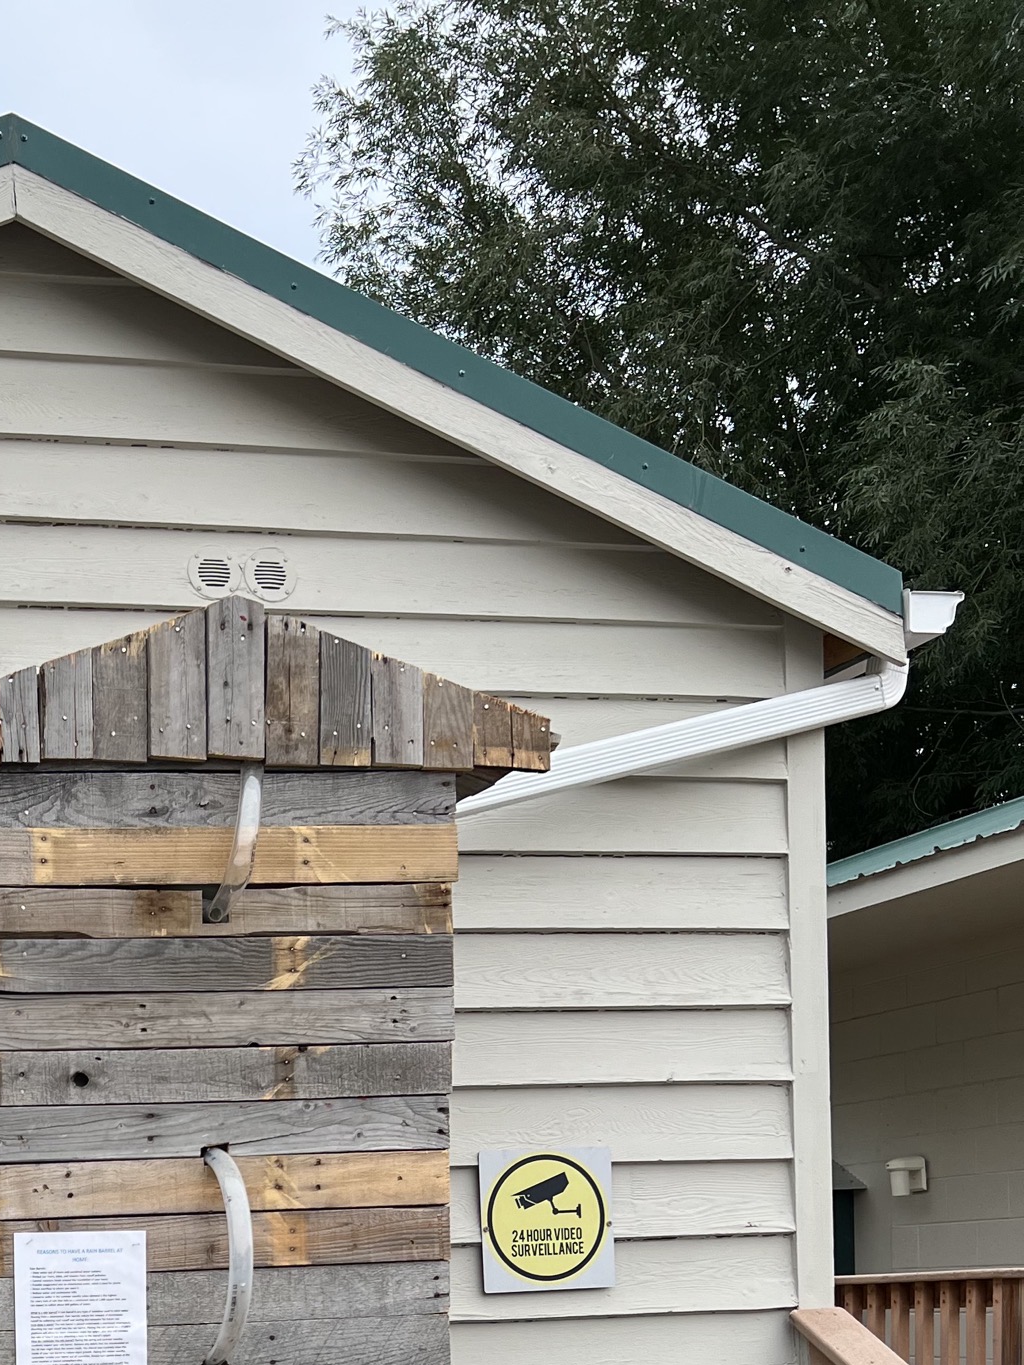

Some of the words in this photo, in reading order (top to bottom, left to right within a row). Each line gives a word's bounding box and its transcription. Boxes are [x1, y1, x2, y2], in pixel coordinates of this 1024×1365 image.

[512, 1229, 525, 1243] 24
[527, 1228, 552, 1242] HOUR
[554, 1227, 582, 1240] VIDEO
[511, 1241, 584, 1257] SURVEILLANCE
